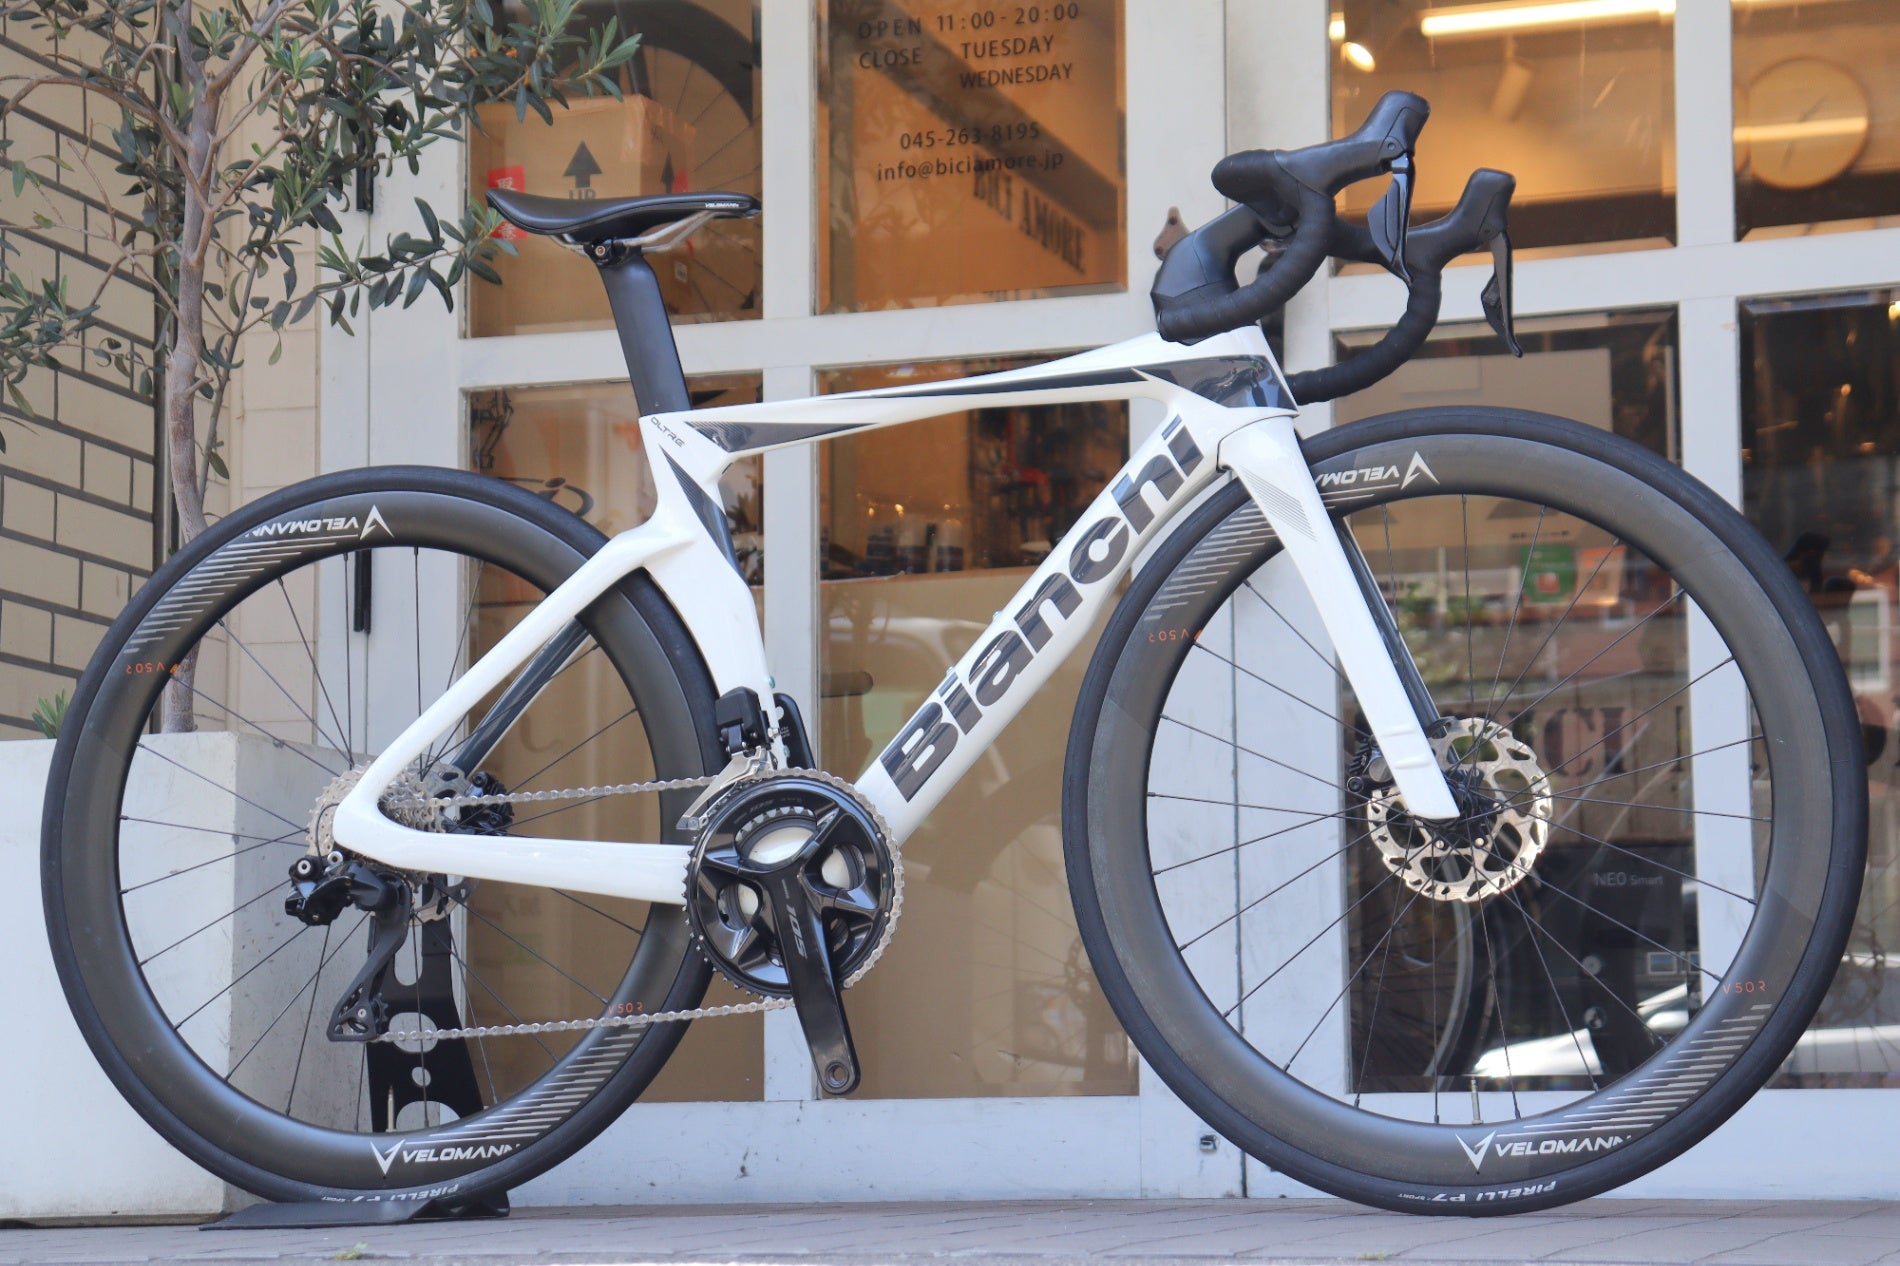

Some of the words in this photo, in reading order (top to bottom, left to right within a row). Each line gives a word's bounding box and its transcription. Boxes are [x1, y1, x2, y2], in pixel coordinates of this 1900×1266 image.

[858, 17, 922, 39] OPEN
[859, 47, 922, 69] CLOSE
[960, 35, 1054, 59] TUESDAY
[959, 62, 1073, 89] WEDNESDAY
[900, 121, 1040, 150] 045-263-8195
[877, 149, 1064, 181] info@biciamore.jp
[650, 416, 685, 447] OLTRE
[879, 414, 1204, 803] Bianchi
[1593, 871, 1627, 887] NEO
[1475, 1180, 1557, 1202] PIRELLI
